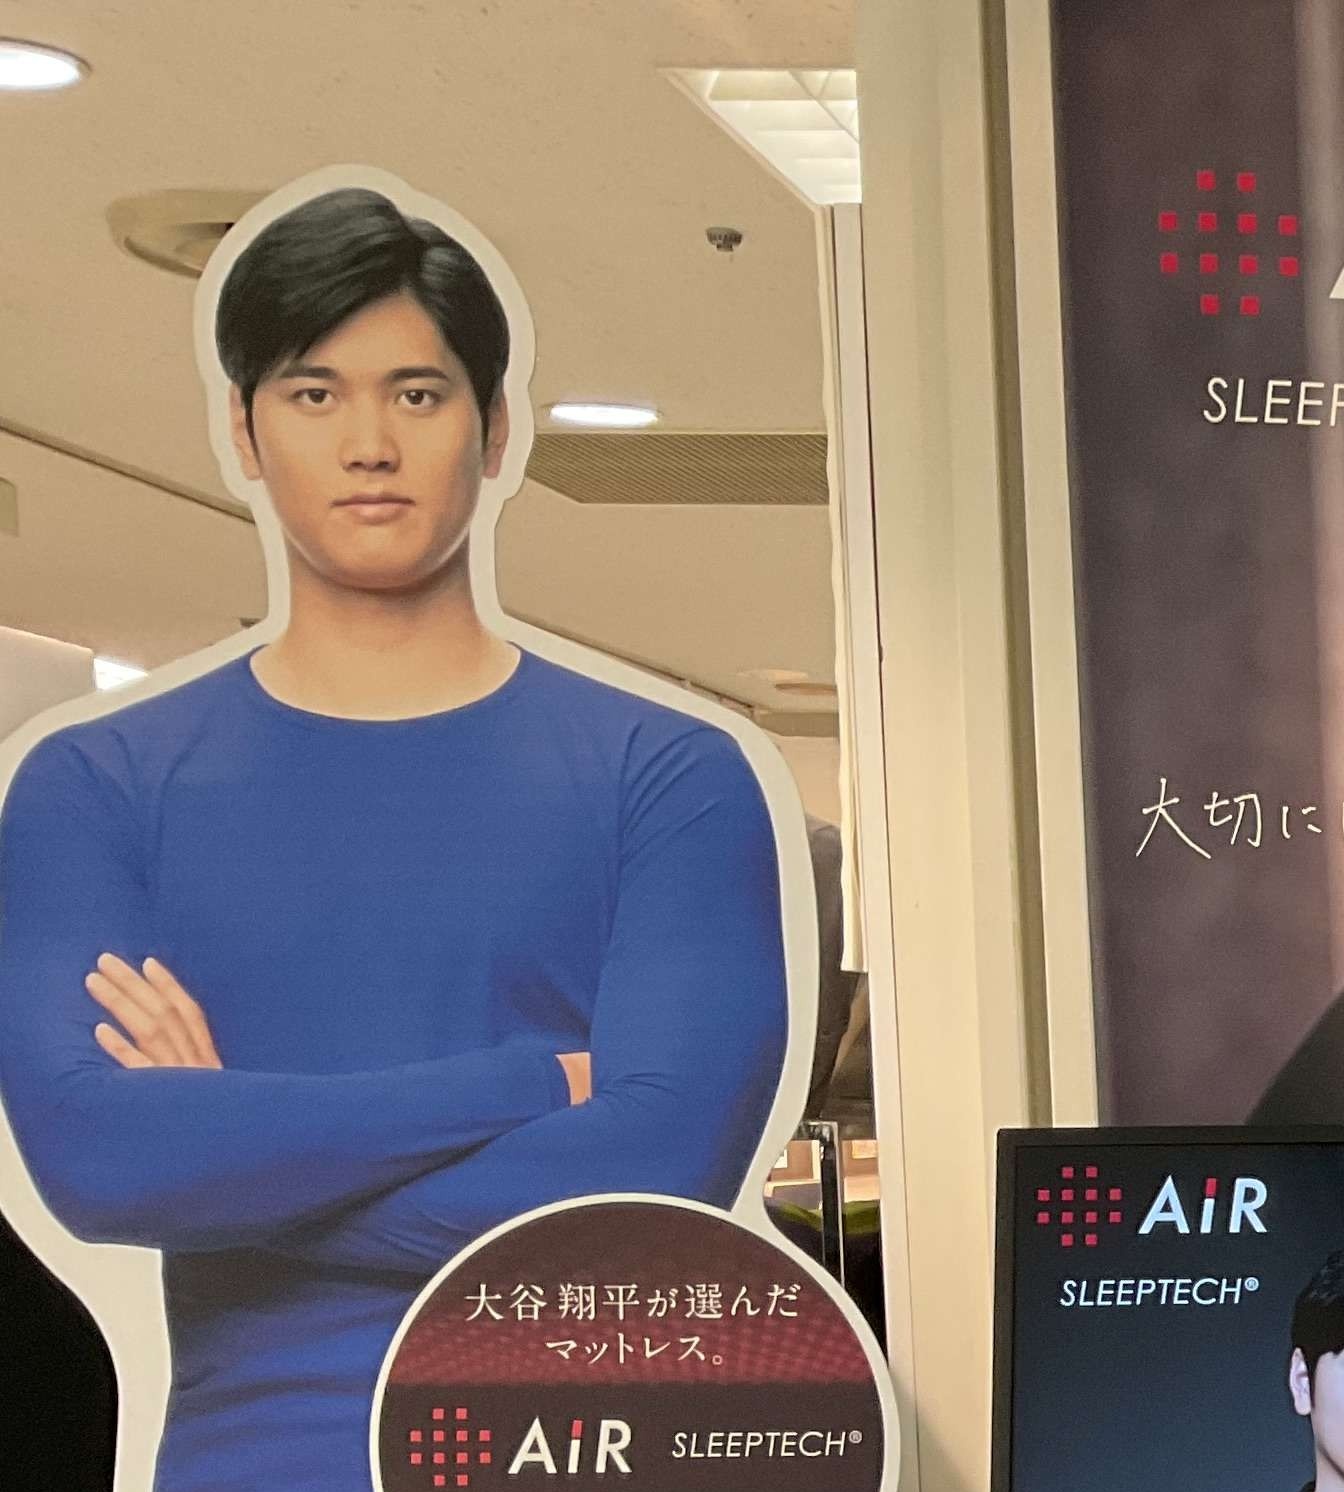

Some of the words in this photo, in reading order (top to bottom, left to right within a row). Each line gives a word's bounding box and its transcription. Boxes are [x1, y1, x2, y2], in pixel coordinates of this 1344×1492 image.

[545, 1332, 724, 1366] マットレス。
